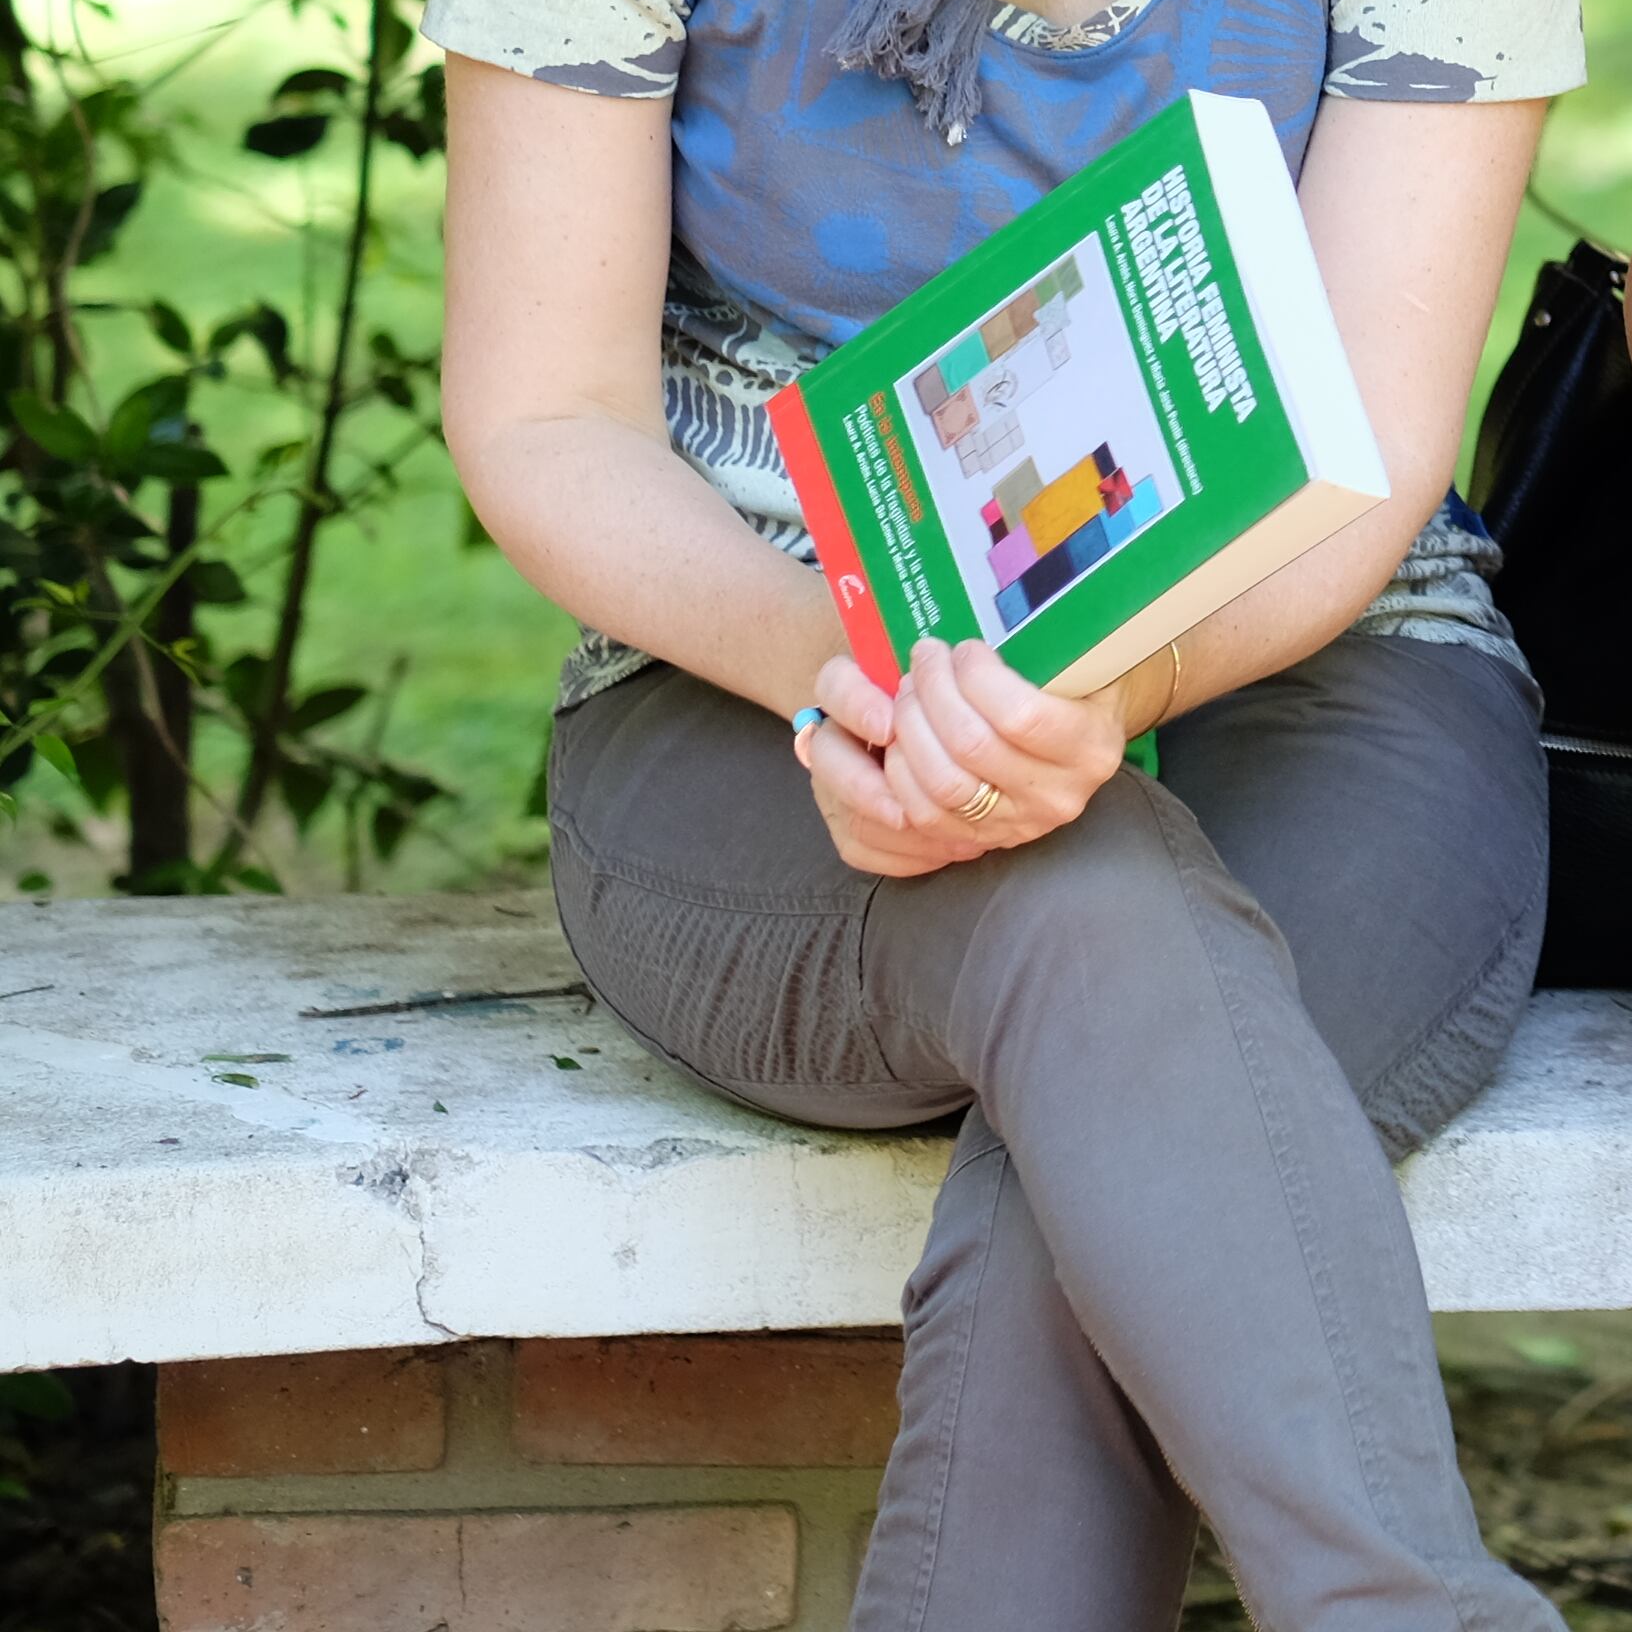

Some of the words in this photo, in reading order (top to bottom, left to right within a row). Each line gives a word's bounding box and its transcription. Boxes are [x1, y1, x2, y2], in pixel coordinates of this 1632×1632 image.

[1141, 180, 1169, 223] DE
[1151, 219, 1179, 263] LA
[1121, 199, 1180, 343] ARGENTINA
[1161, 257, 1228, 412] LITERATURA
[1162, 165, 1212, 287] HISTORIA
[1195, 282, 1257, 423] FEMINISTA
[873, 458, 887, 476] de
[880, 475, 892, 492] la
[902, 549, 916, 560] y
[909, 558, 922, 575] la
